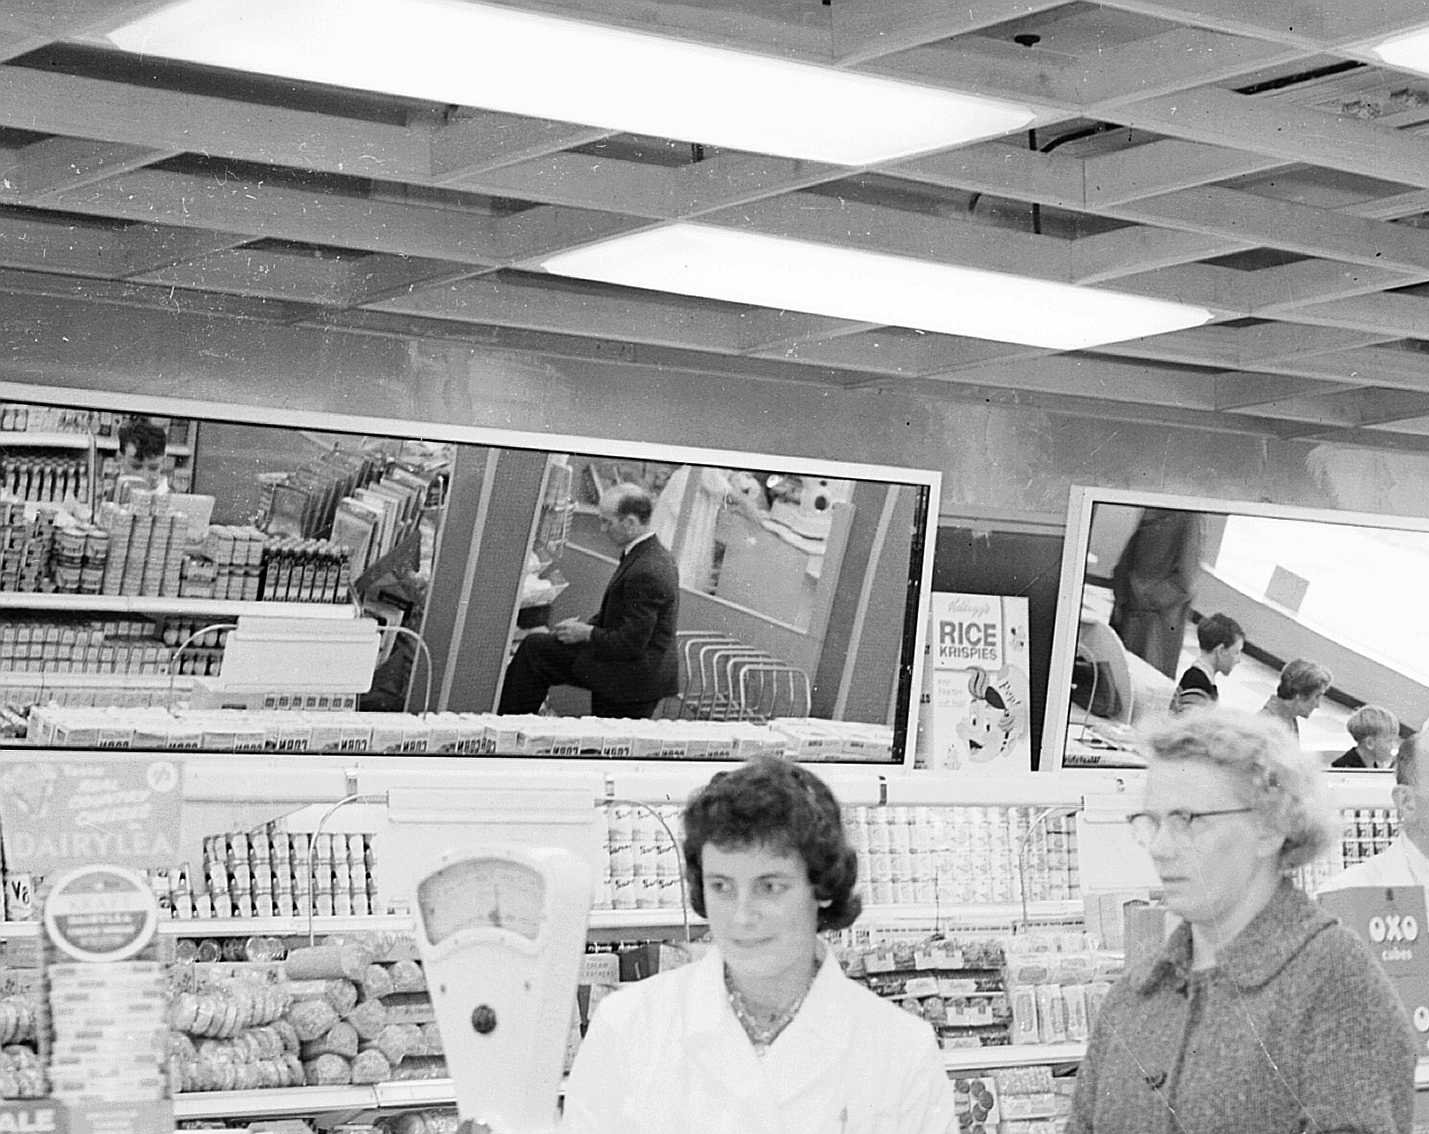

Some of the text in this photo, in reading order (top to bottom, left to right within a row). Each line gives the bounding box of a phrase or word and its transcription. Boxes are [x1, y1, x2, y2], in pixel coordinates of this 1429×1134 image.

[939, 620, 998, 647] RICE
[939, 646, 998, 661] KRISPIES
[13, 832, 174, 858] DAIRYLEA
[1370, 914, 1418, 943] OXO
[1382, 946, 1413, 962] cubes
